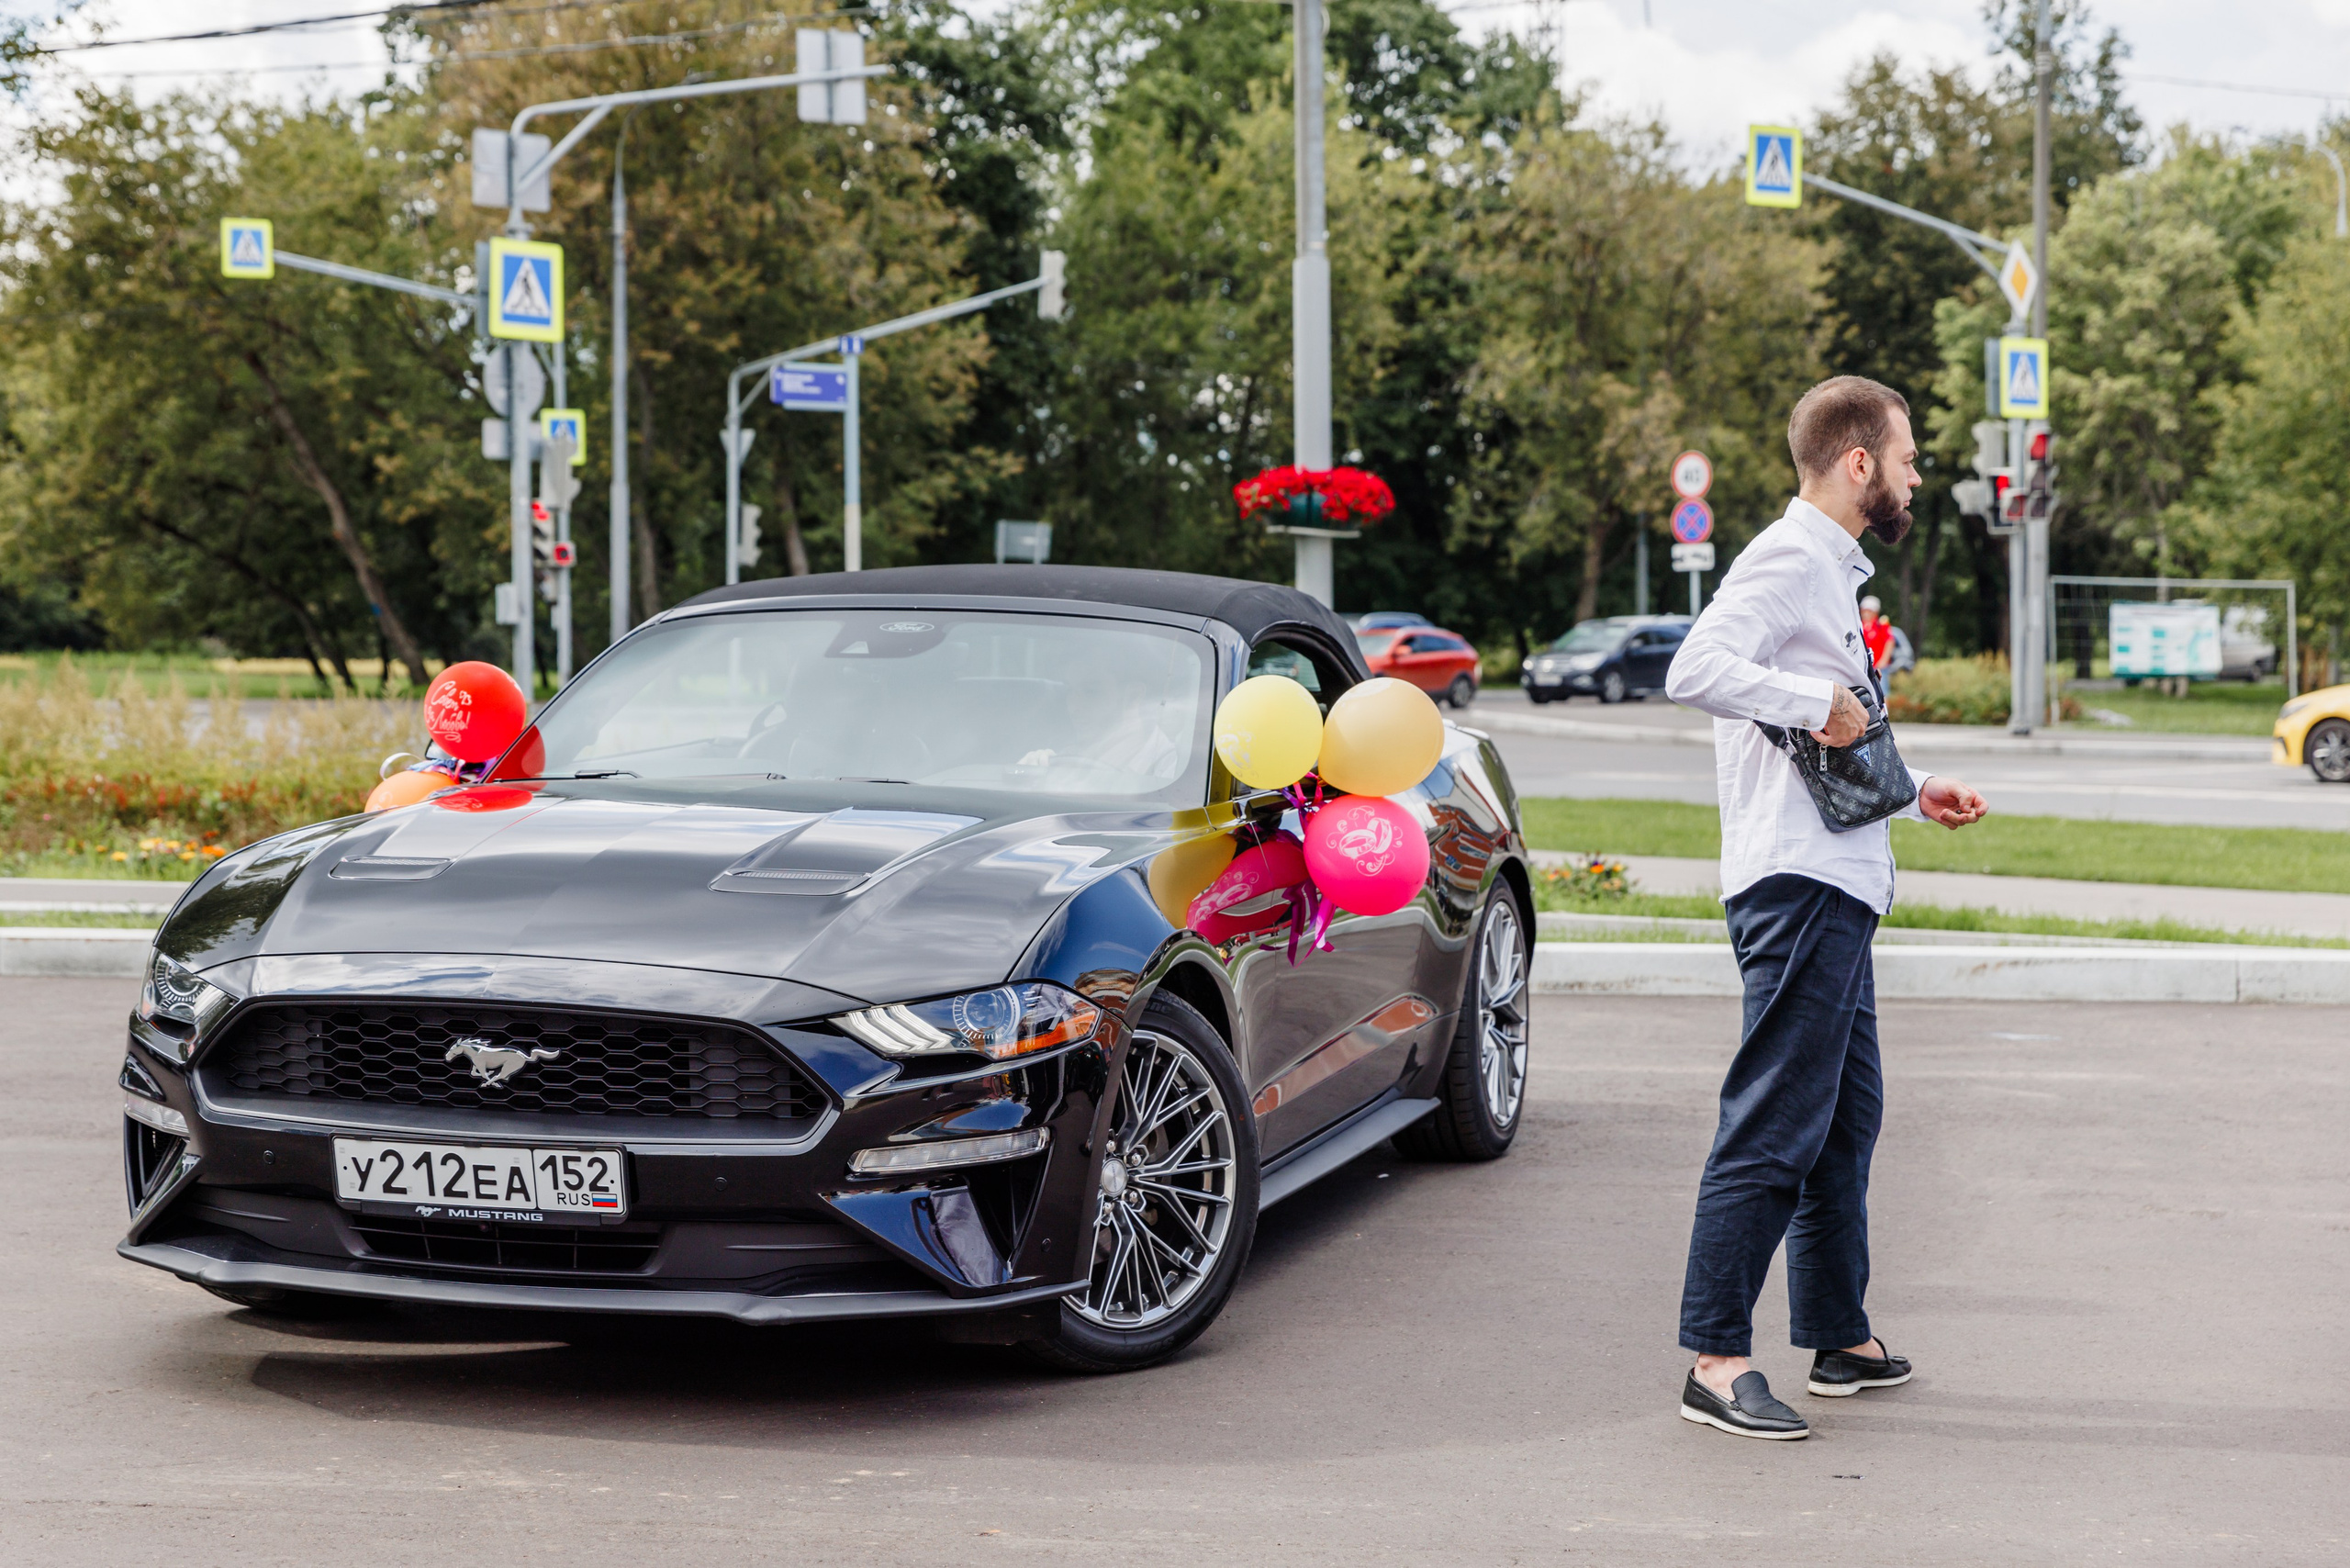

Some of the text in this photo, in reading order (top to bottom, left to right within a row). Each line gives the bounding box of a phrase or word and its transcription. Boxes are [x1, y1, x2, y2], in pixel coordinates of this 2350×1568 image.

[539, 1154, 610, 1193] 152
[556, 1193, 590, 1206] RUS
[448, 1208, 543, 1222] MUSTANG
